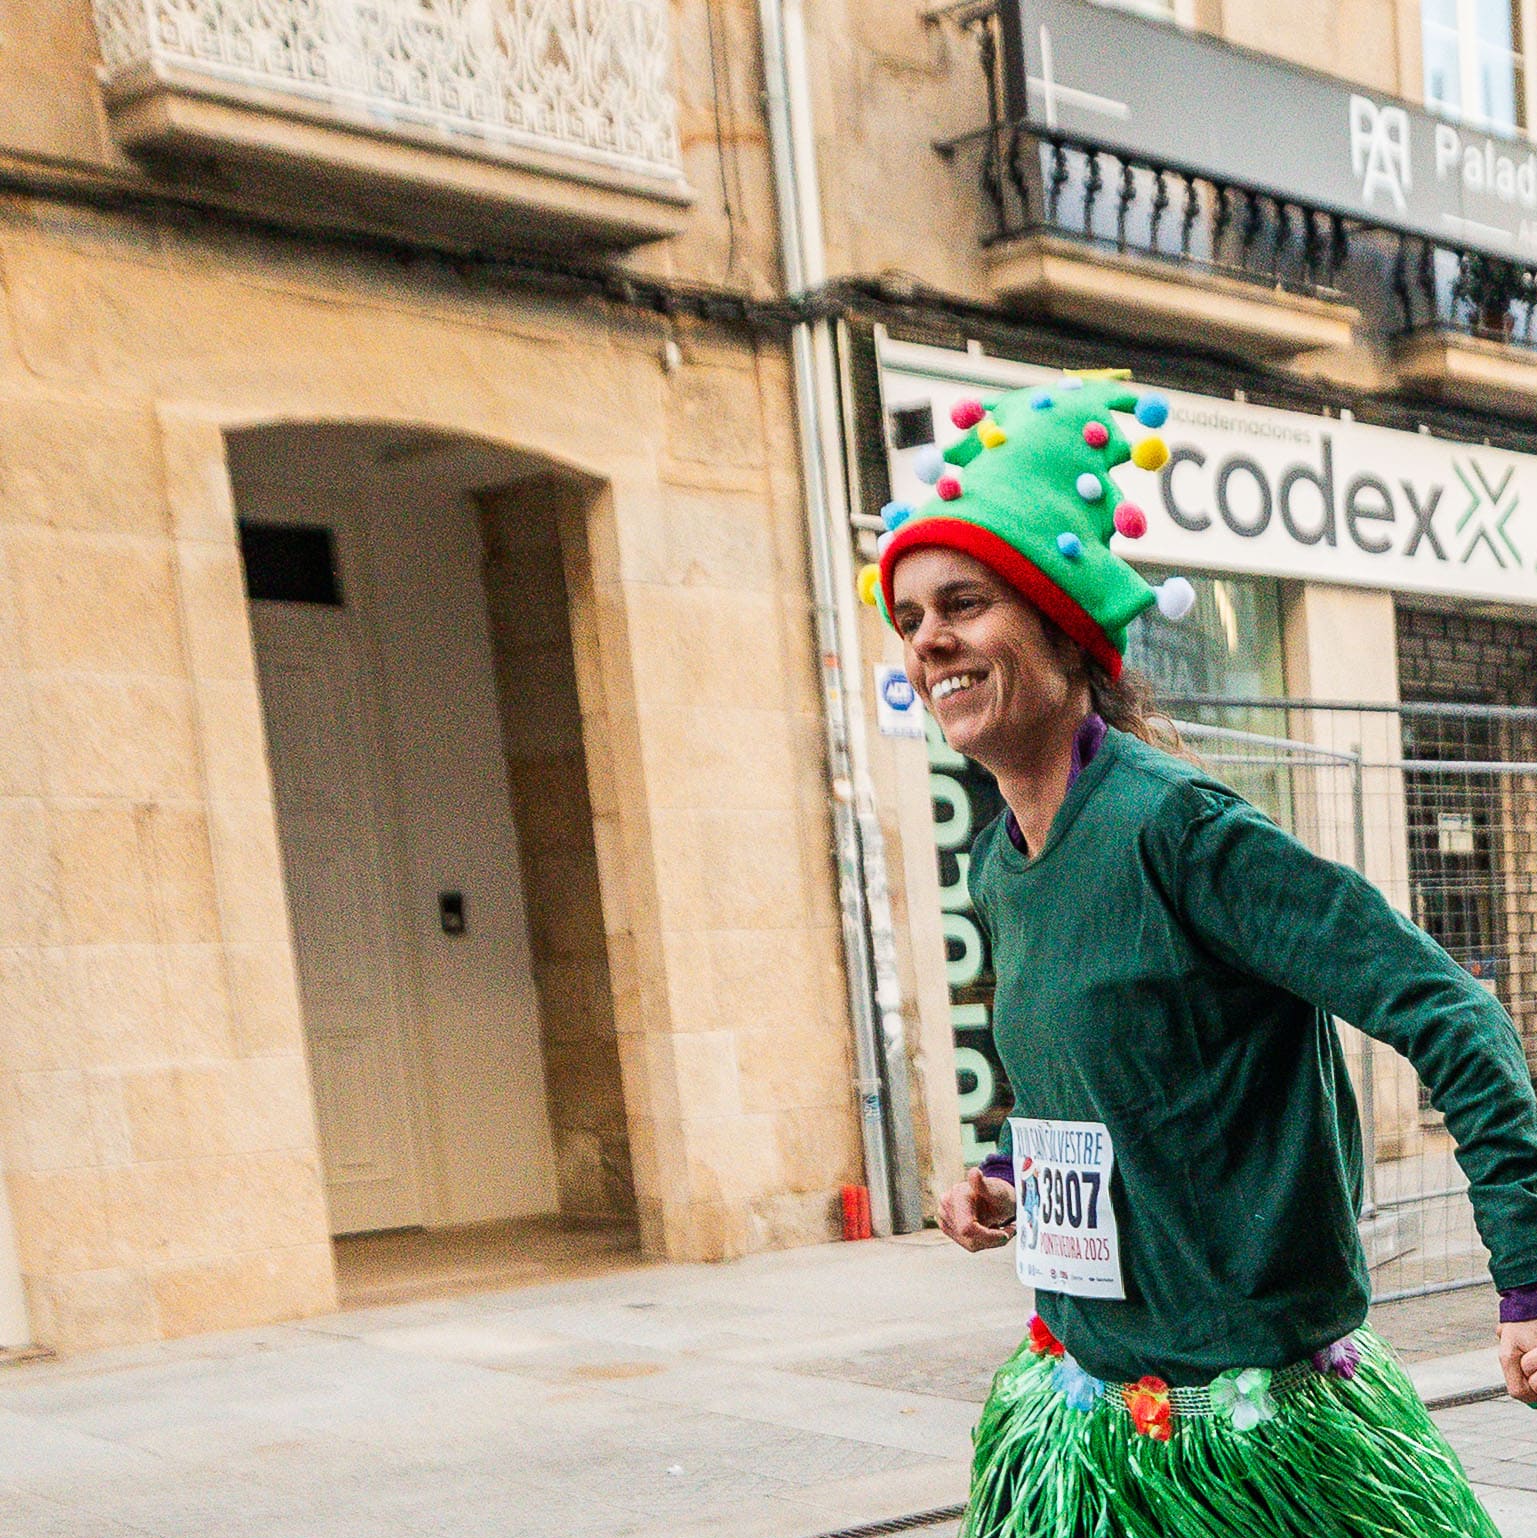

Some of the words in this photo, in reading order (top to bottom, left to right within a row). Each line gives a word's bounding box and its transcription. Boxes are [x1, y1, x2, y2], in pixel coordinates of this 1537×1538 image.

[1160, 433, 1448, 561] codex
[1046, 1130, 1103, 1166] SILVESTRE
[1042, 1166, 1101, 1230] 3907
[1040, 1231, 1083, 1261] PONTEVEDRA
[1084, 1237, 1111, 1262] 2025
